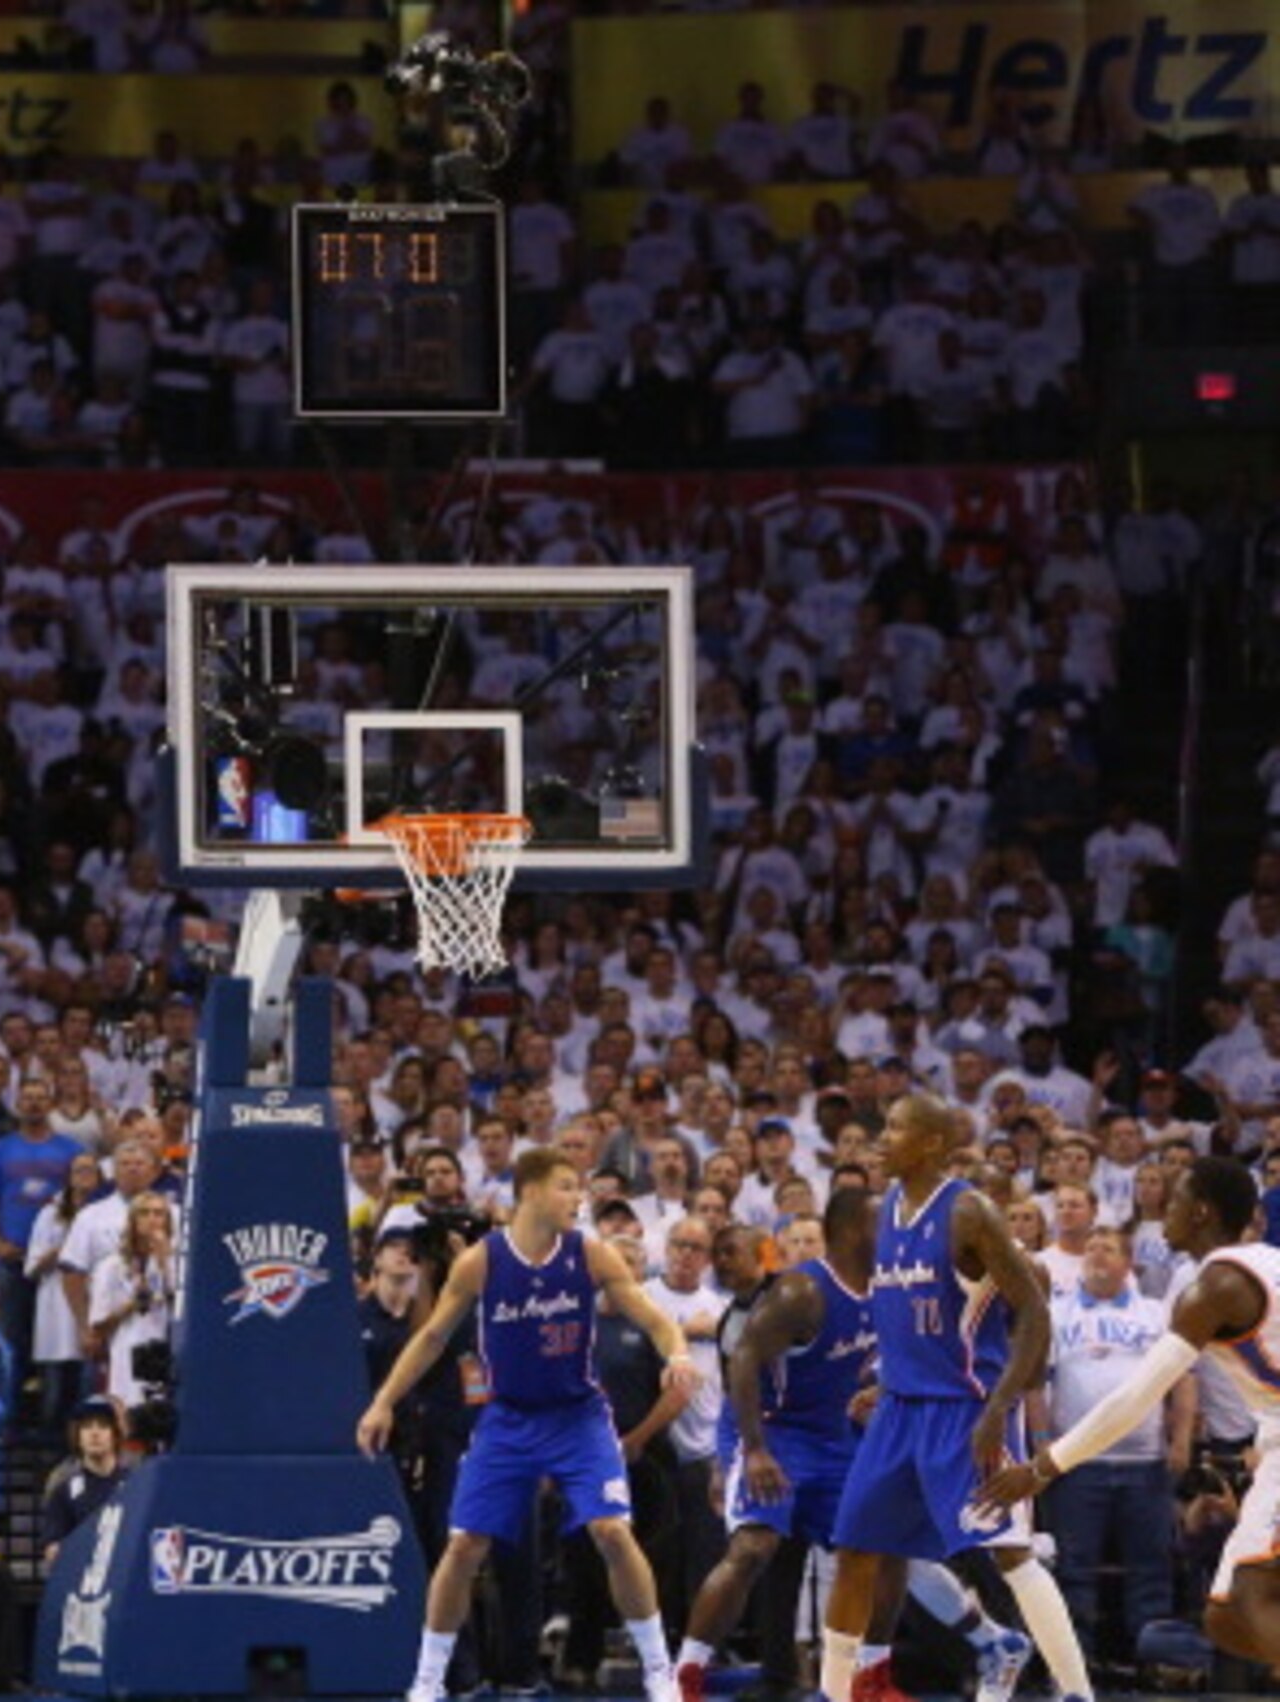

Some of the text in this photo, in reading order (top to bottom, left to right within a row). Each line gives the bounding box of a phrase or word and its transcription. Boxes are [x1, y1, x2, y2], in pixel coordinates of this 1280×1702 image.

[894, 15, 1268, 128] Hertz
[221, 1222, 329, 1266] THUNDER
[492, 1290, 580, 1323] Los Angeles
[183, 1545, 395, 1586] PLAYOFFS
